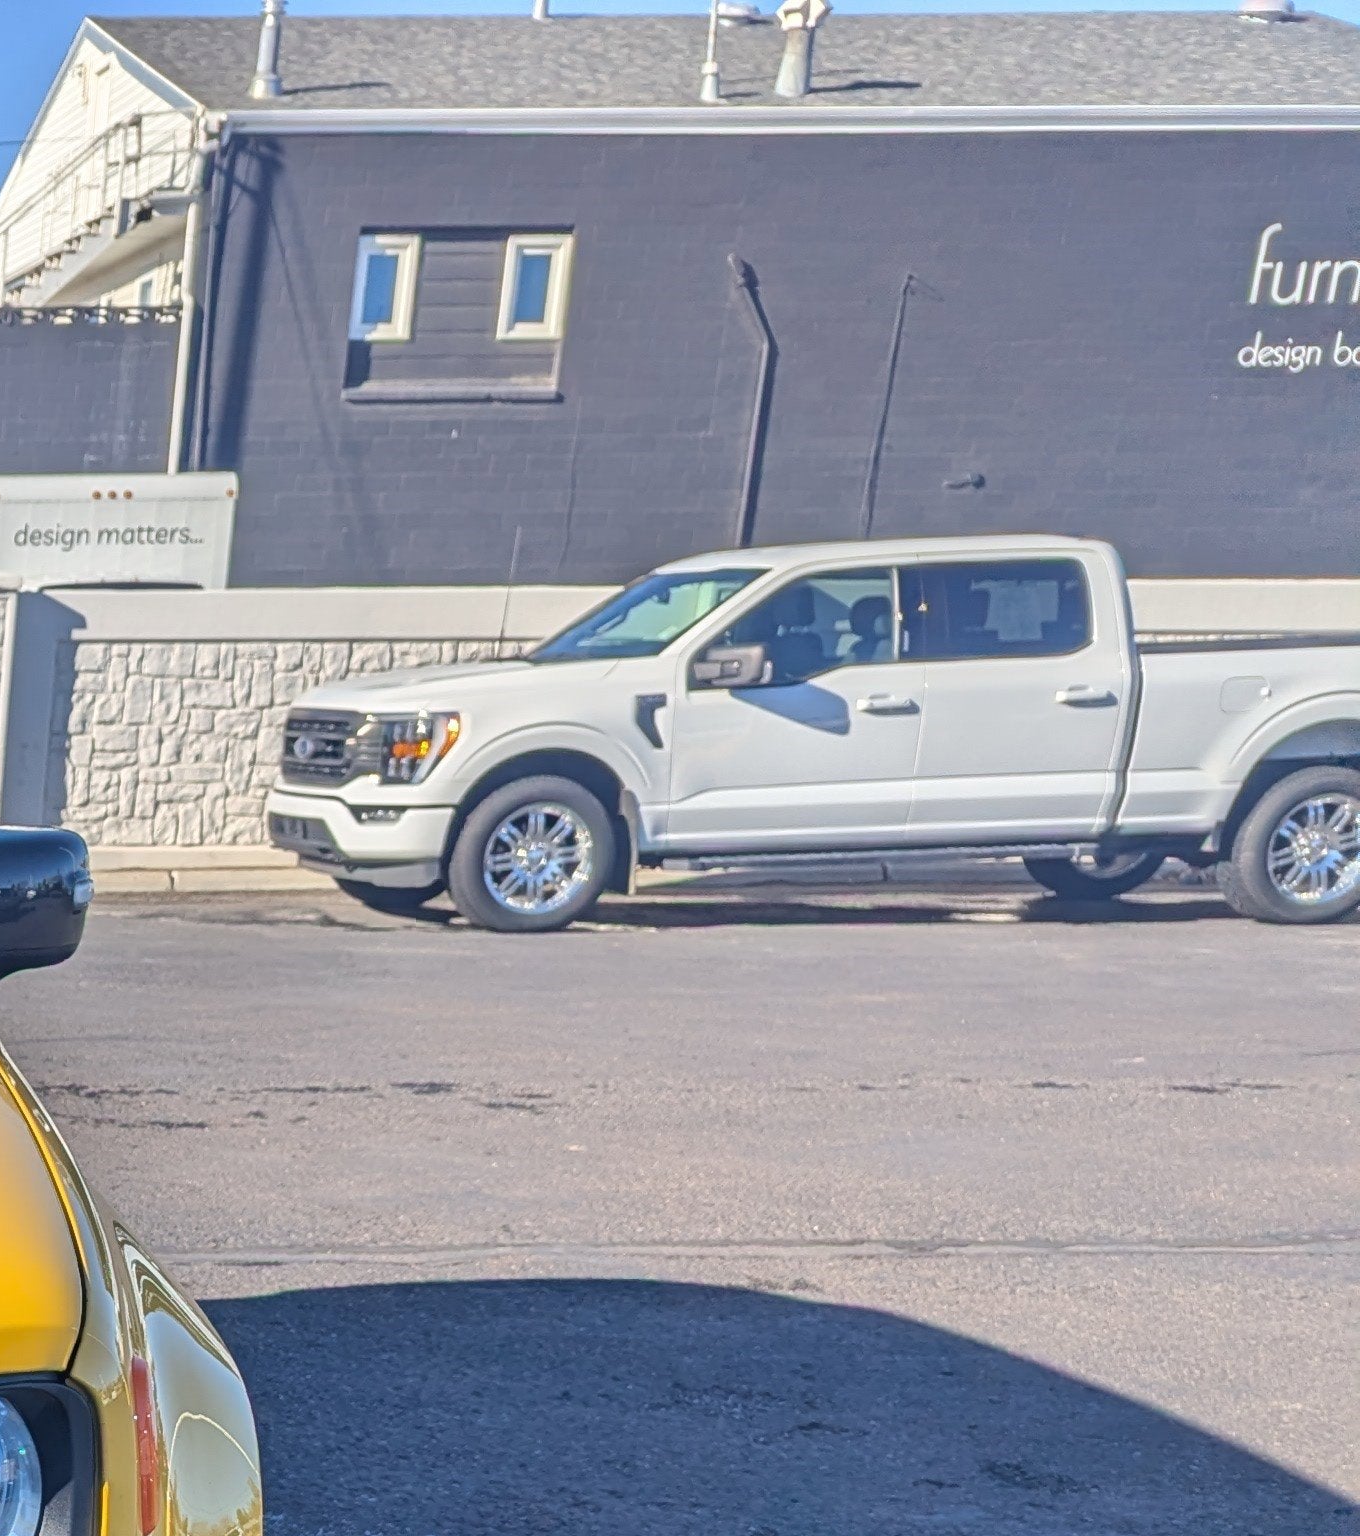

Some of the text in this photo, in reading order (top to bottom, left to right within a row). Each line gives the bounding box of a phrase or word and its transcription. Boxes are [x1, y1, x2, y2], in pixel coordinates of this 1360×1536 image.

[1248, 222, 1360, 305] furn
[1237, 330, 1323, 374] design
[13, 522, 90, 552] design
